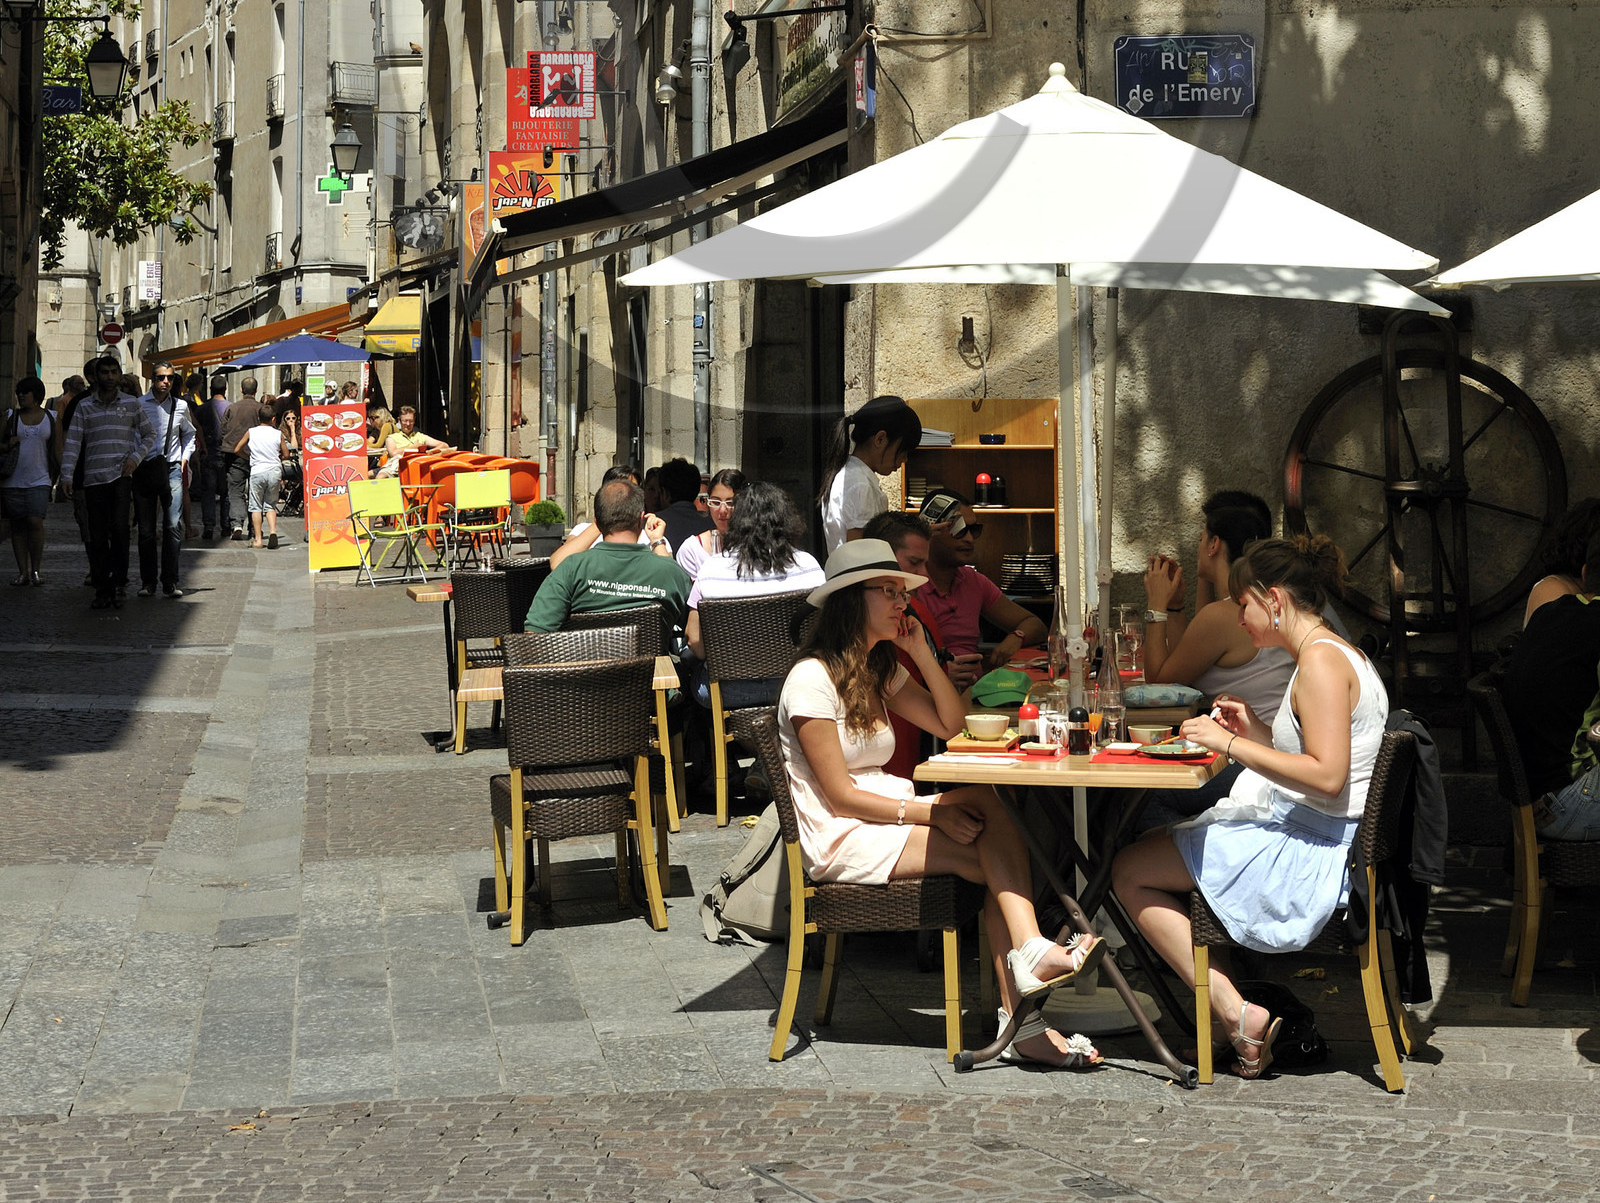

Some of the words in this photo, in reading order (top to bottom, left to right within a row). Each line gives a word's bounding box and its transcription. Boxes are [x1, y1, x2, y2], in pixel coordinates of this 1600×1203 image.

[540, 53, 595, 65] BARABLABLA
[1161, 51, 1207, 71] RU
[43, 88, 77, 109] Bar
[1128, 84, 1154, 102] de
[1164, 83, 1242, 105] l'Emery
[512, 121, 573, 130] BIJOUTERIE
[516, 131, 569, 140] FANTAISIE
[512, 141, 573, 151] CREATURS
